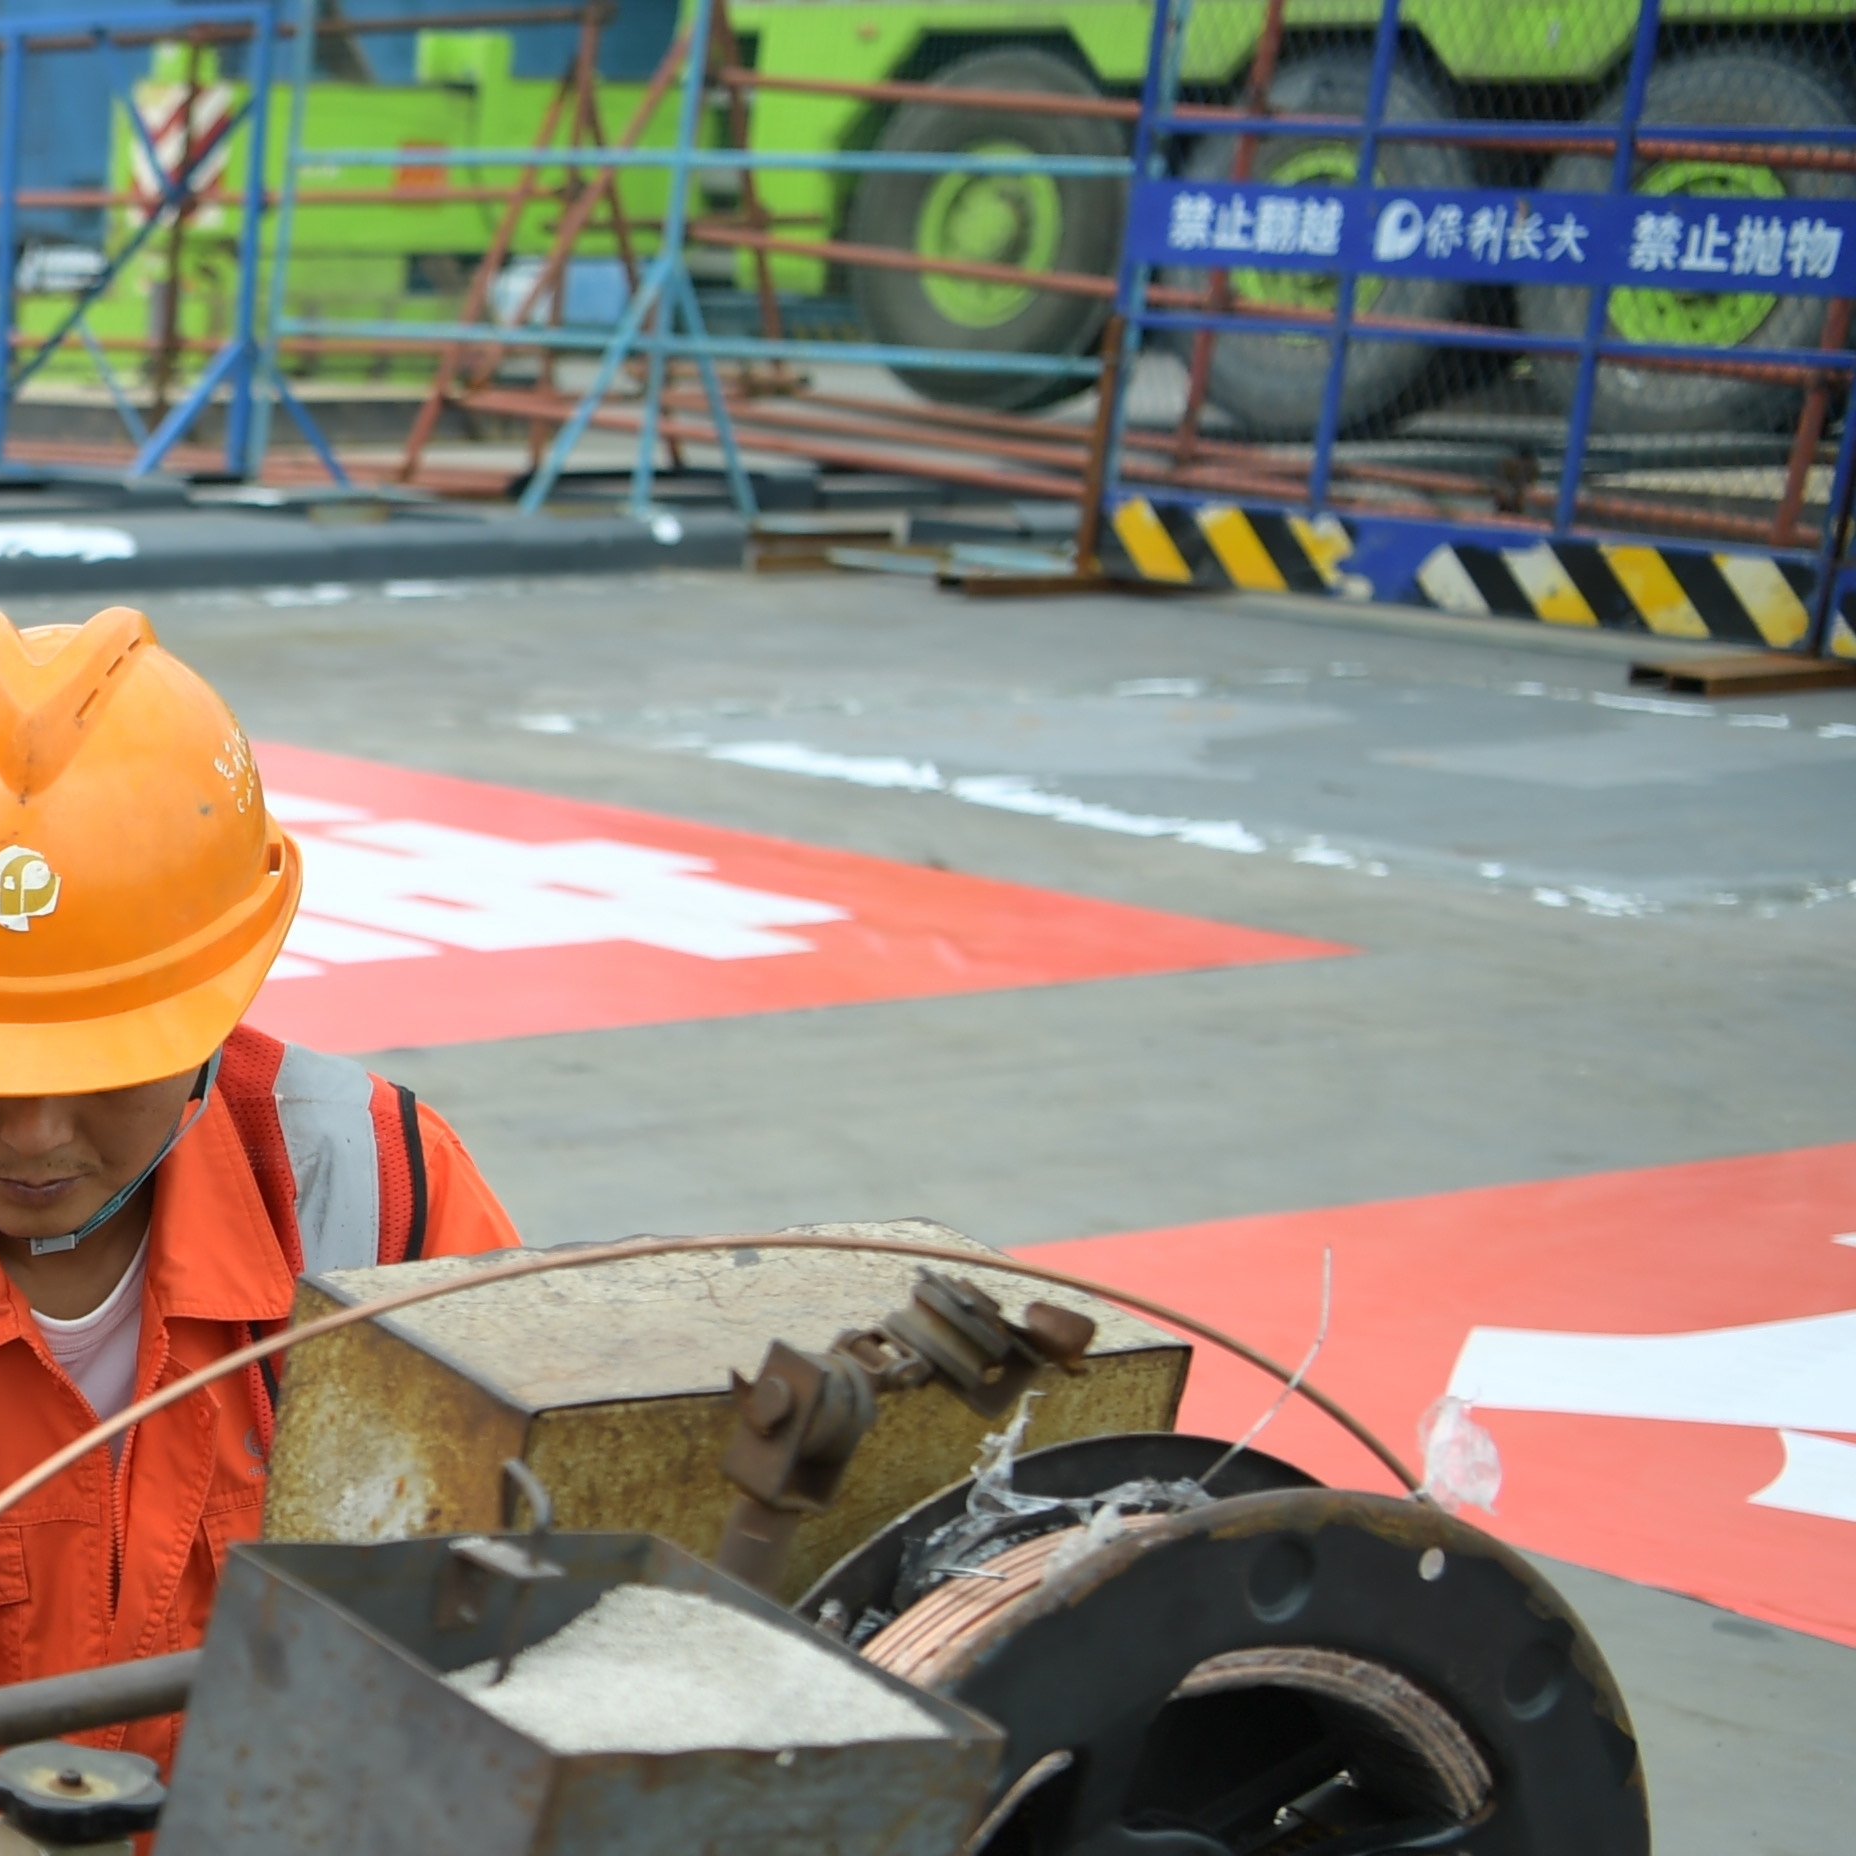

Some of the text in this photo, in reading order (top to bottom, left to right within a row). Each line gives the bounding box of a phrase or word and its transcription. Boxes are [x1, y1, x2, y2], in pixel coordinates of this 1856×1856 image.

[1168, 191, 1344, 256] 禁止翻越
[1425, 204, 1589, 264] 保利长大
[1629, 211, 1844, 279] 禁止抛物
